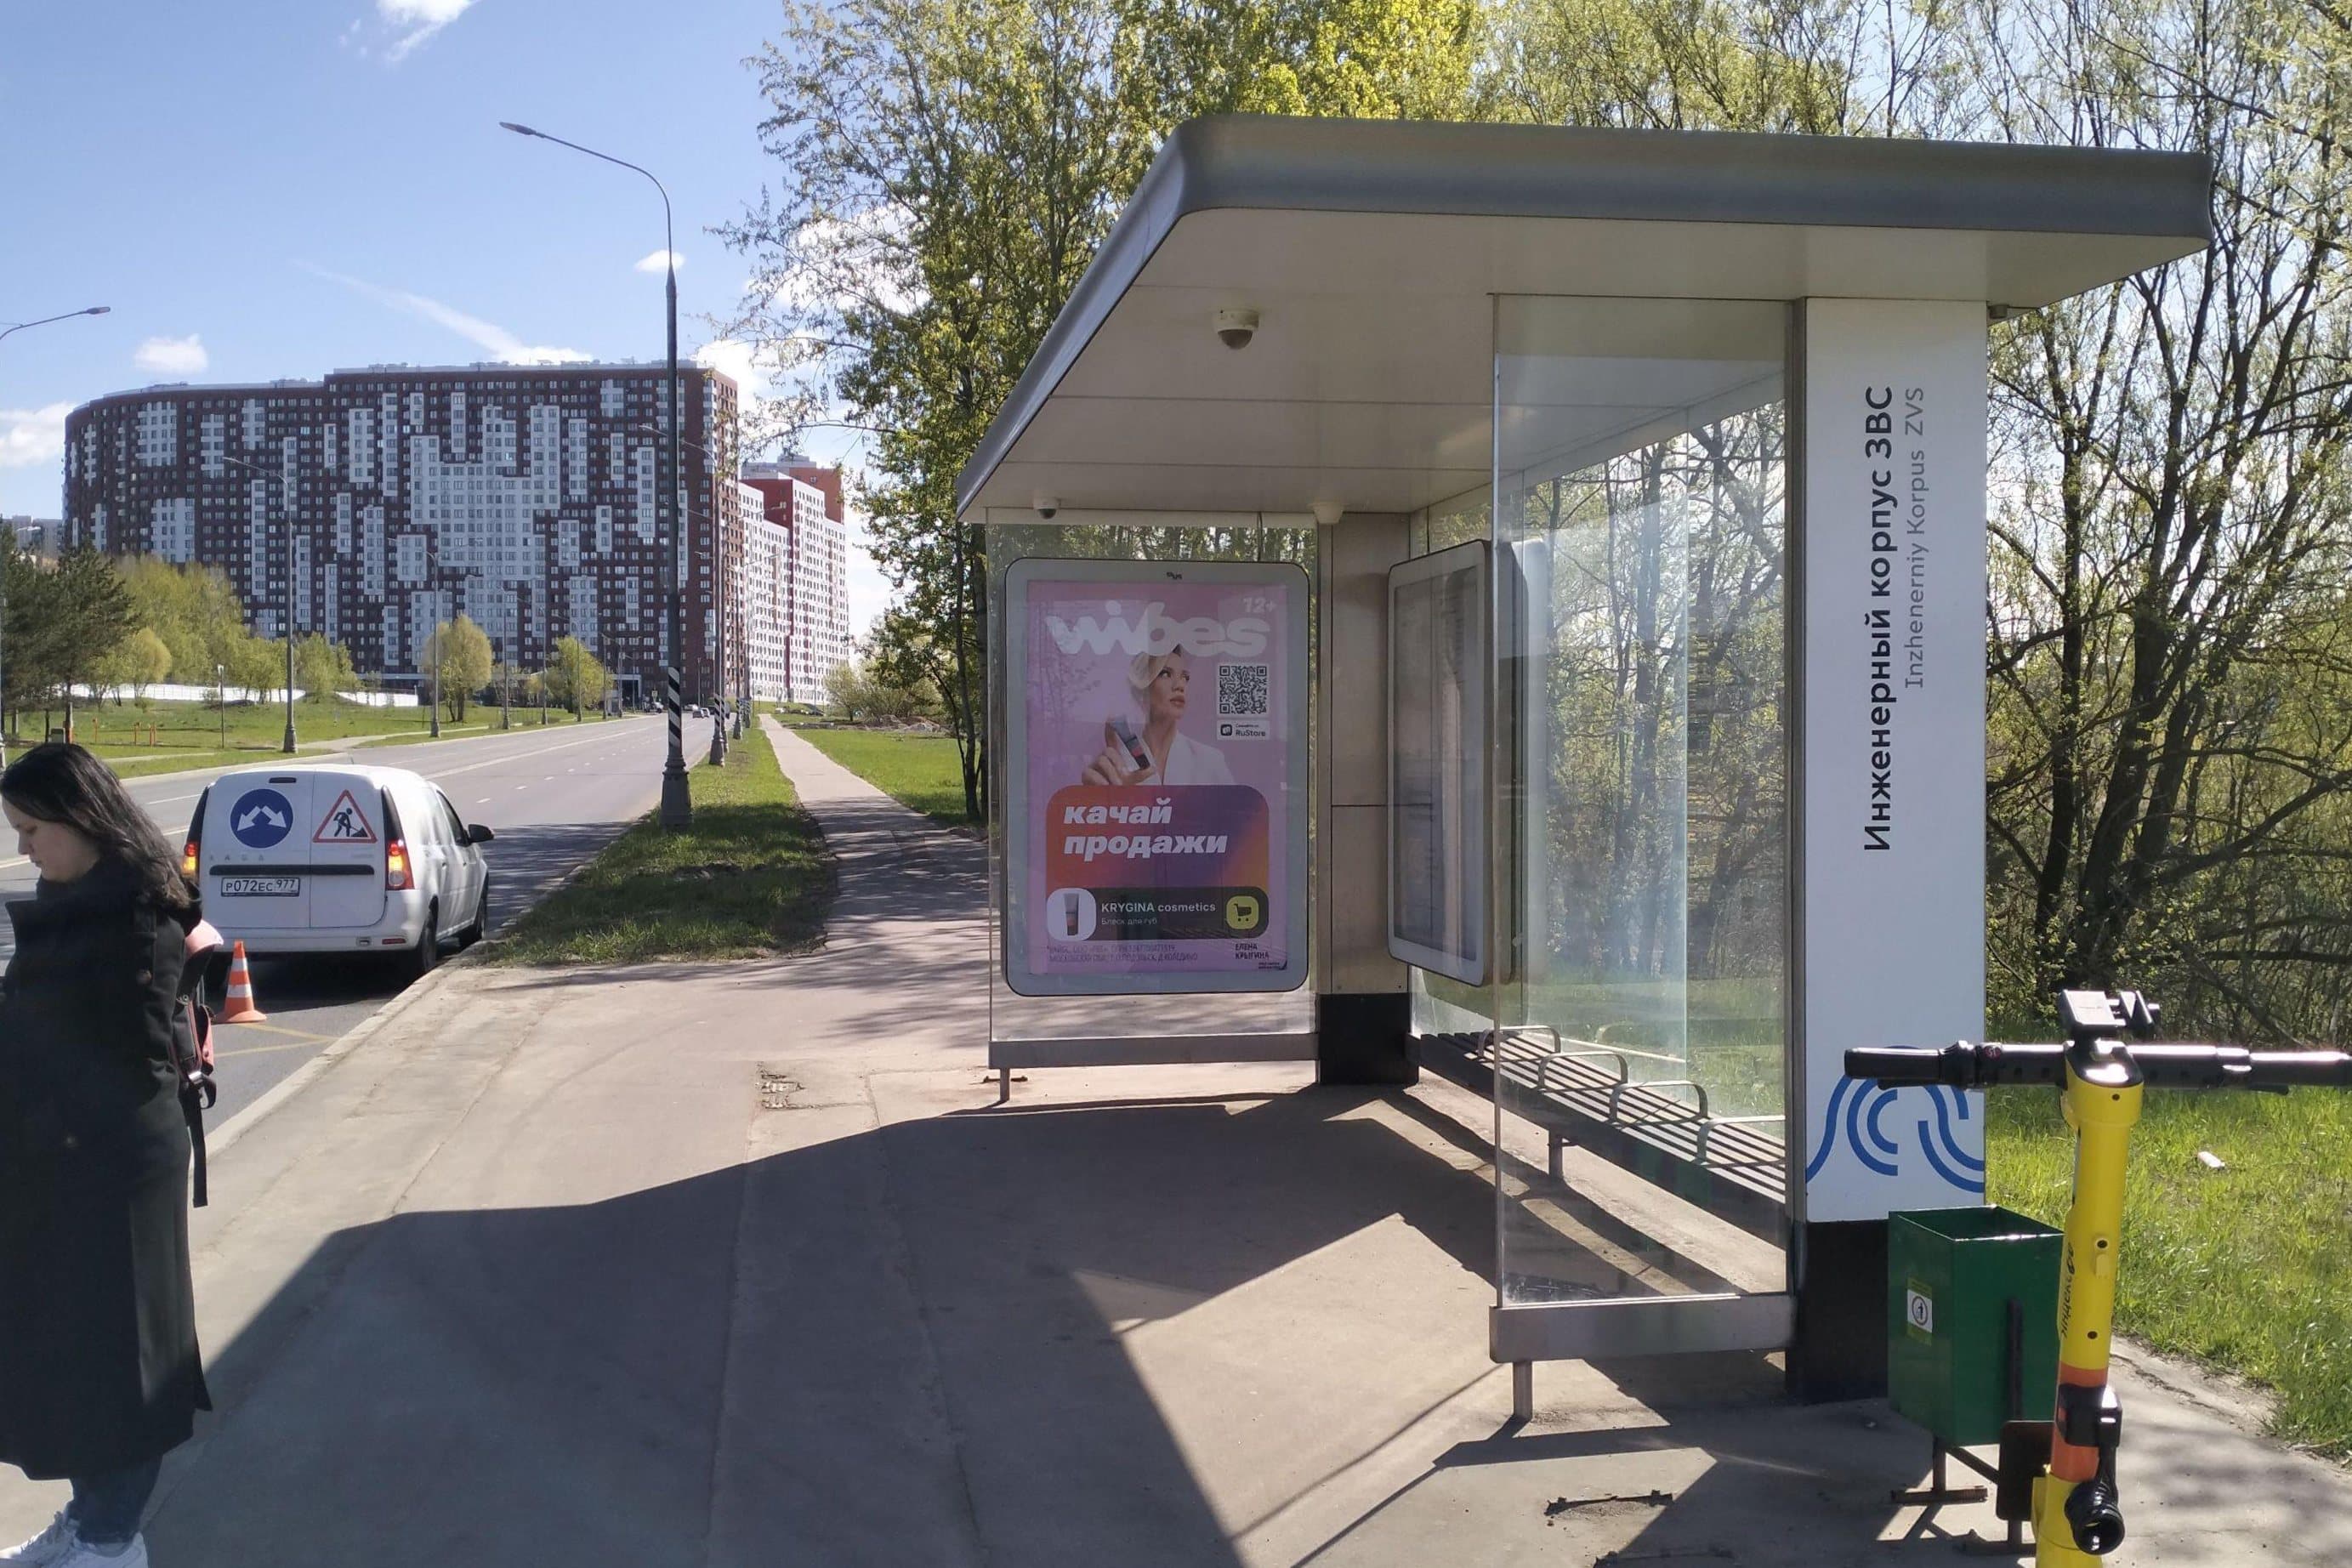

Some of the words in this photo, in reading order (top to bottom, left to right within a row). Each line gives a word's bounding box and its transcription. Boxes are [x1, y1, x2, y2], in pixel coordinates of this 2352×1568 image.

[1865, 385, 1893, 460] ЗВС
[1905, 387, 1924, 437] ZVS
[1906, 449, 1930, 535] Korpus
[1871, 469, 1899, 597] корпус
[1904, 542, 1930, 690] Inzhenerniy
[1863, 609, 1897, 851] Инженерный
[1064, 798, 1173, 824] качай
[1064, 834, 1228, 861] продажи
[1101, 902, 1155, 912] KRYGINA
[1157, 901, 1216, 912] cosmetics
